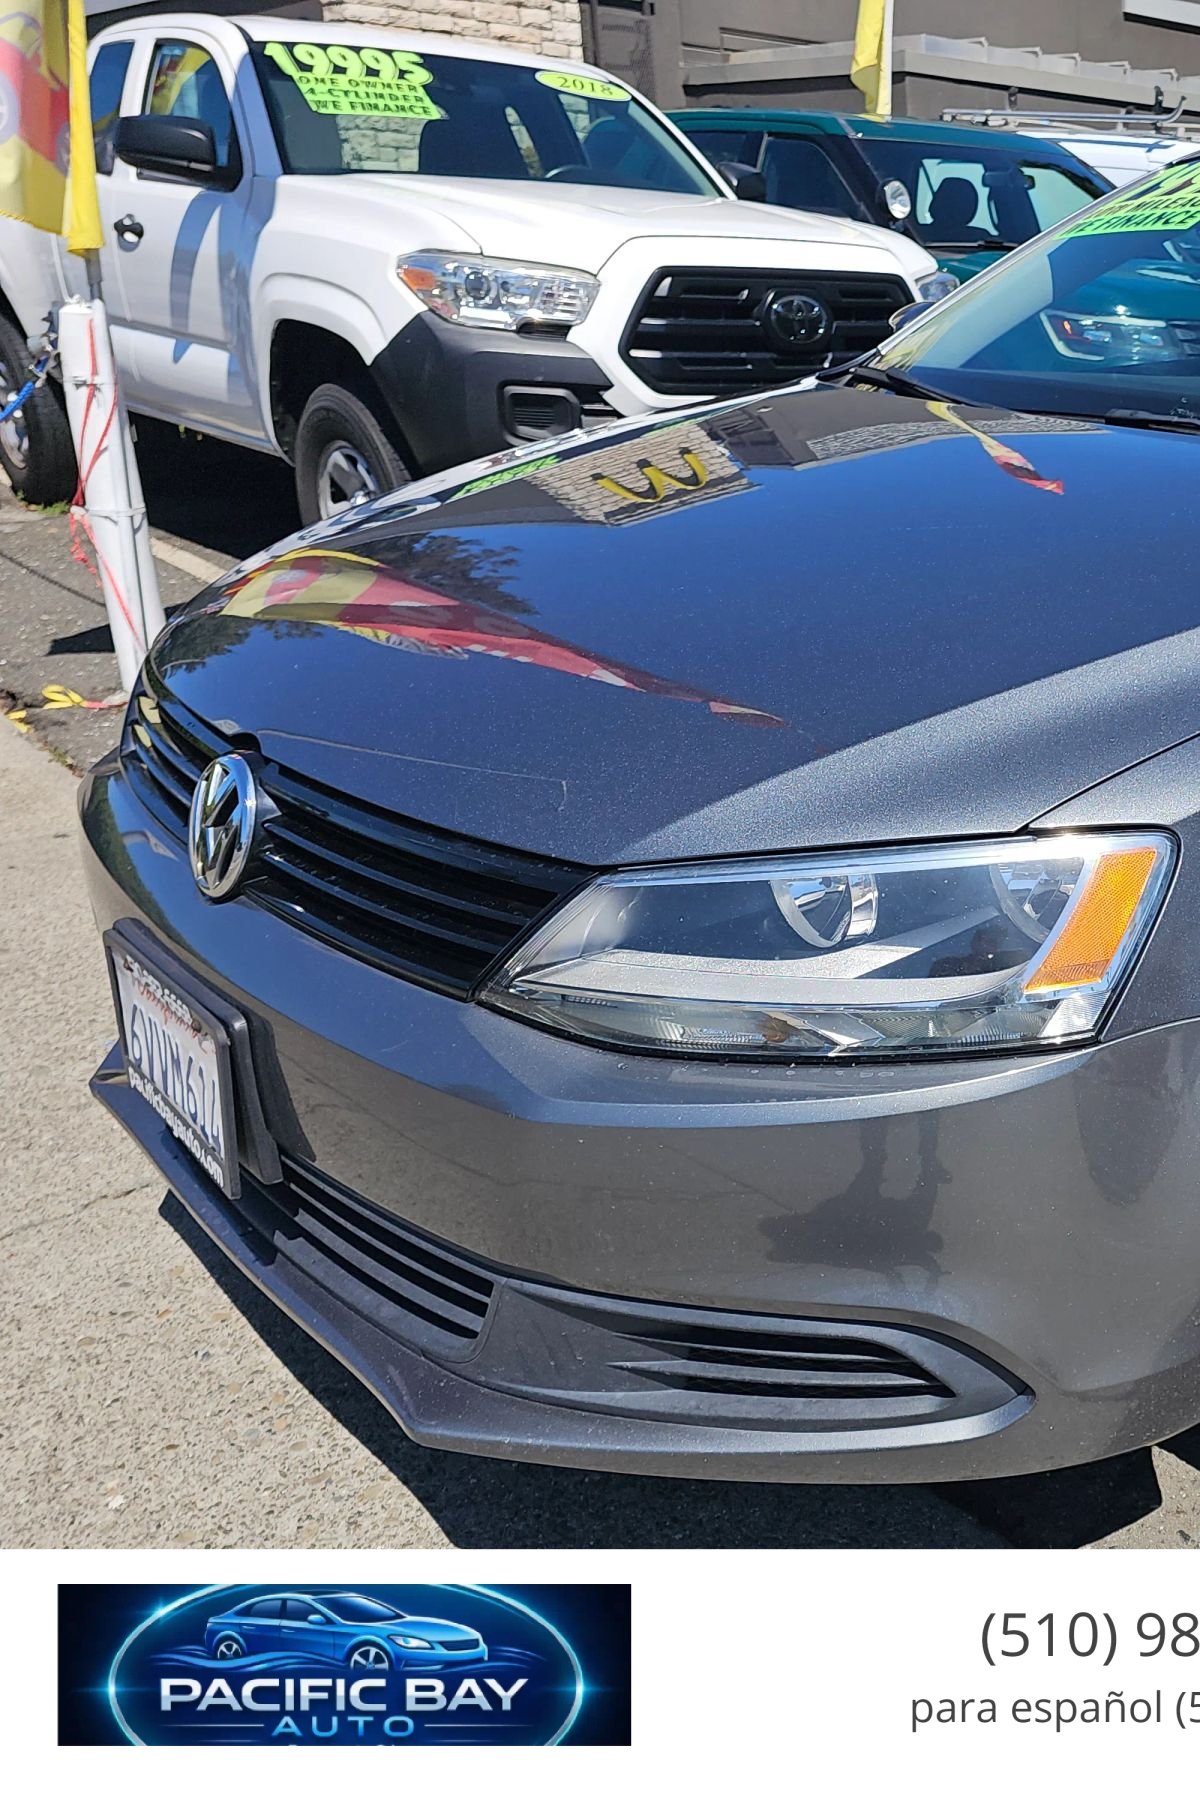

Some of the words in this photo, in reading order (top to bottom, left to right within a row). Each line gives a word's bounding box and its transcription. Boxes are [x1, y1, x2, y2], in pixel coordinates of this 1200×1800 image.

[264, 42, 433, 85] 19995
[299, 76, 340, 86] ONE
[349, 78, 420, 94] OWNER
[557, 76, 613, 96] 2018
[313, 100, 344, 112] WE
[350, 101, 434, 117] FINANCE
